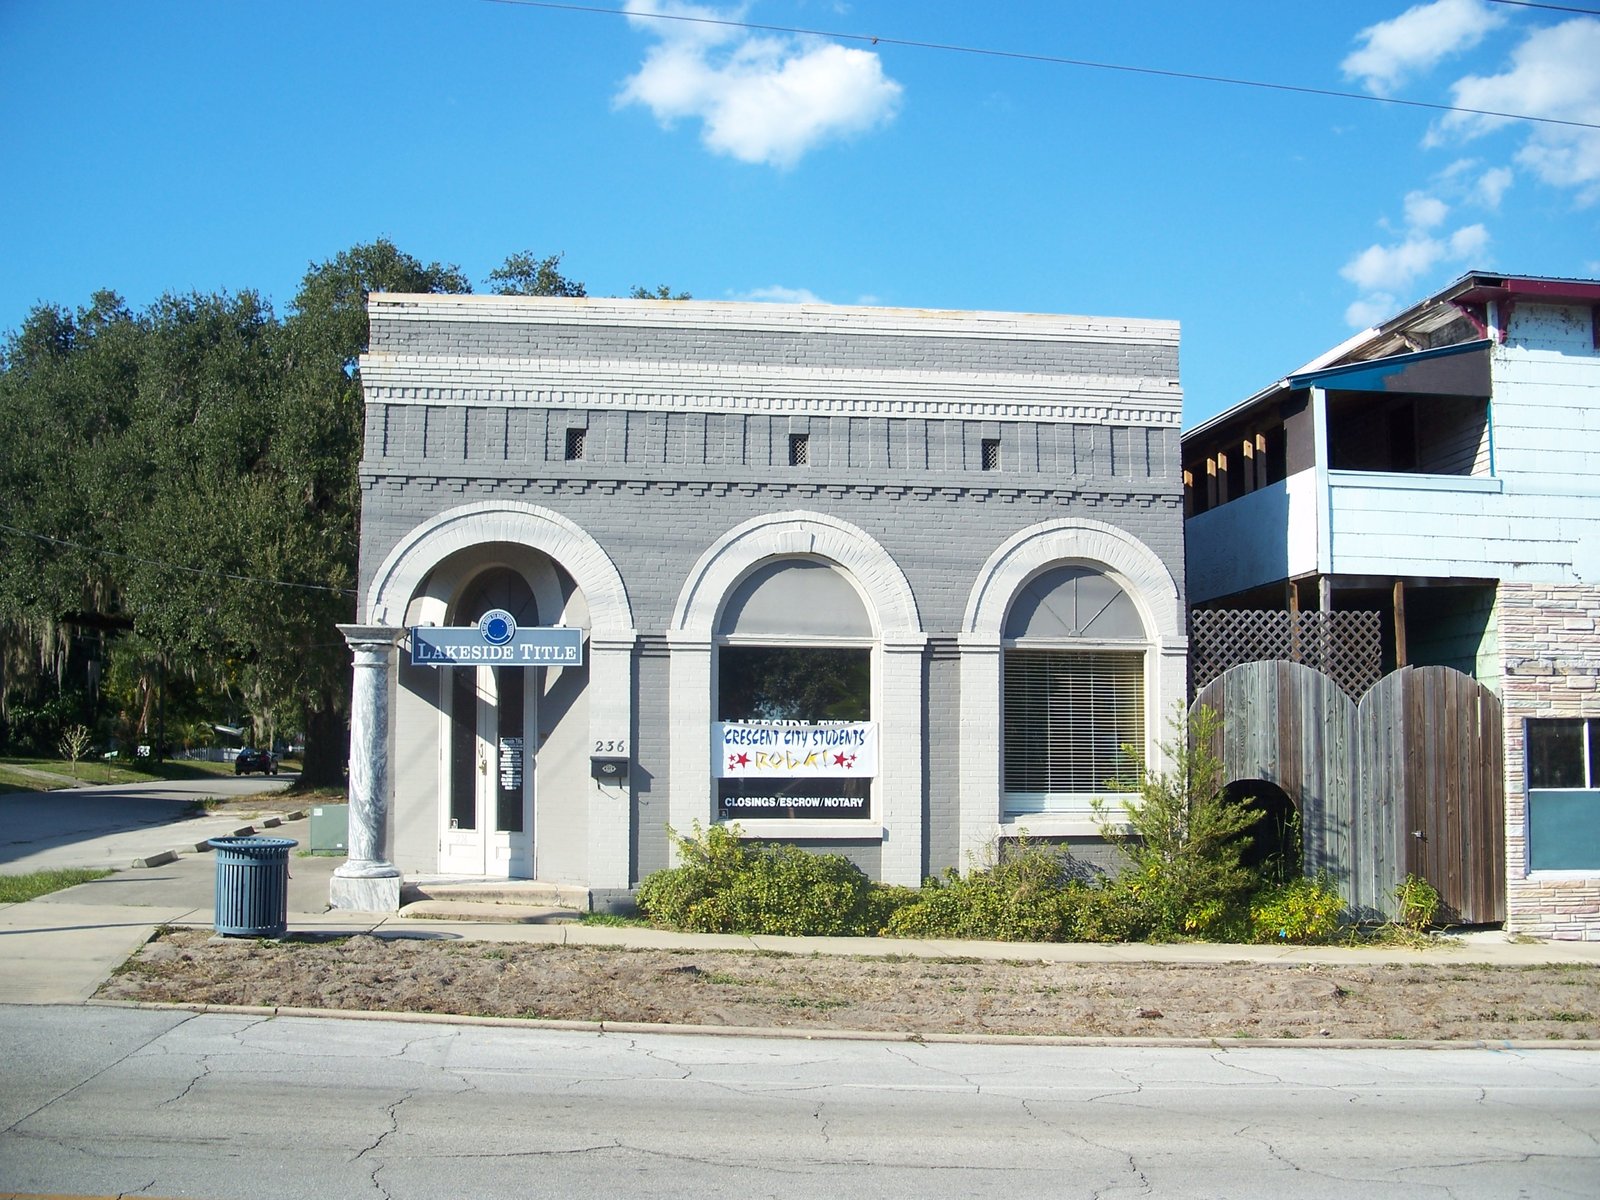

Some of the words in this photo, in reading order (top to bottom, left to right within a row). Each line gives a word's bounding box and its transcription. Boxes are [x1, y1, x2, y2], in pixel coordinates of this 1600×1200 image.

[417, 643, 514, 660] LAKESIDE
[520, 643, 577, 660] TITLE
[595, 740, 625, 752] 236
[724, 728, 779, 746] CRESCENT
[784, 729, 808, 748] CITY
[812, 728, 865, 746] STUDENTS
